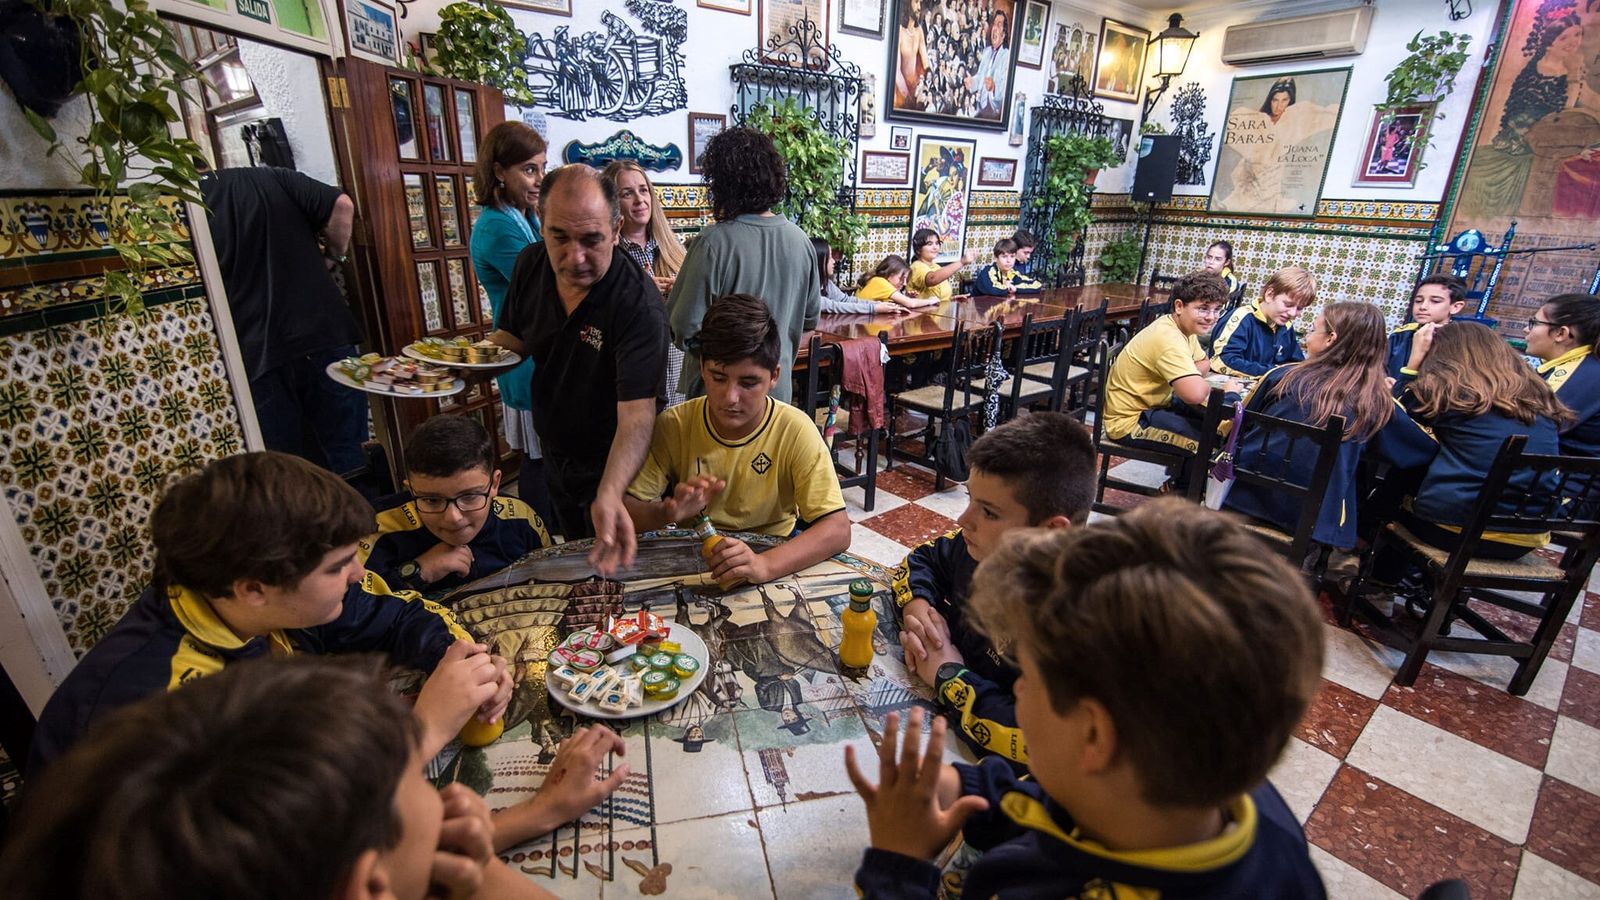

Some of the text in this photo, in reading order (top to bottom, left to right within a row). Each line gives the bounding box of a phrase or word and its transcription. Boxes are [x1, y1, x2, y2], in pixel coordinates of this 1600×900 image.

[237, 0, 269, 19] SALIDA
[1227, 117, 1267, 130] SARA
[1225, 132, 1275, 145] BARAS
[401, 504, 417, 525] LICEO
[1010, 734, 1018, 759] LICEO
